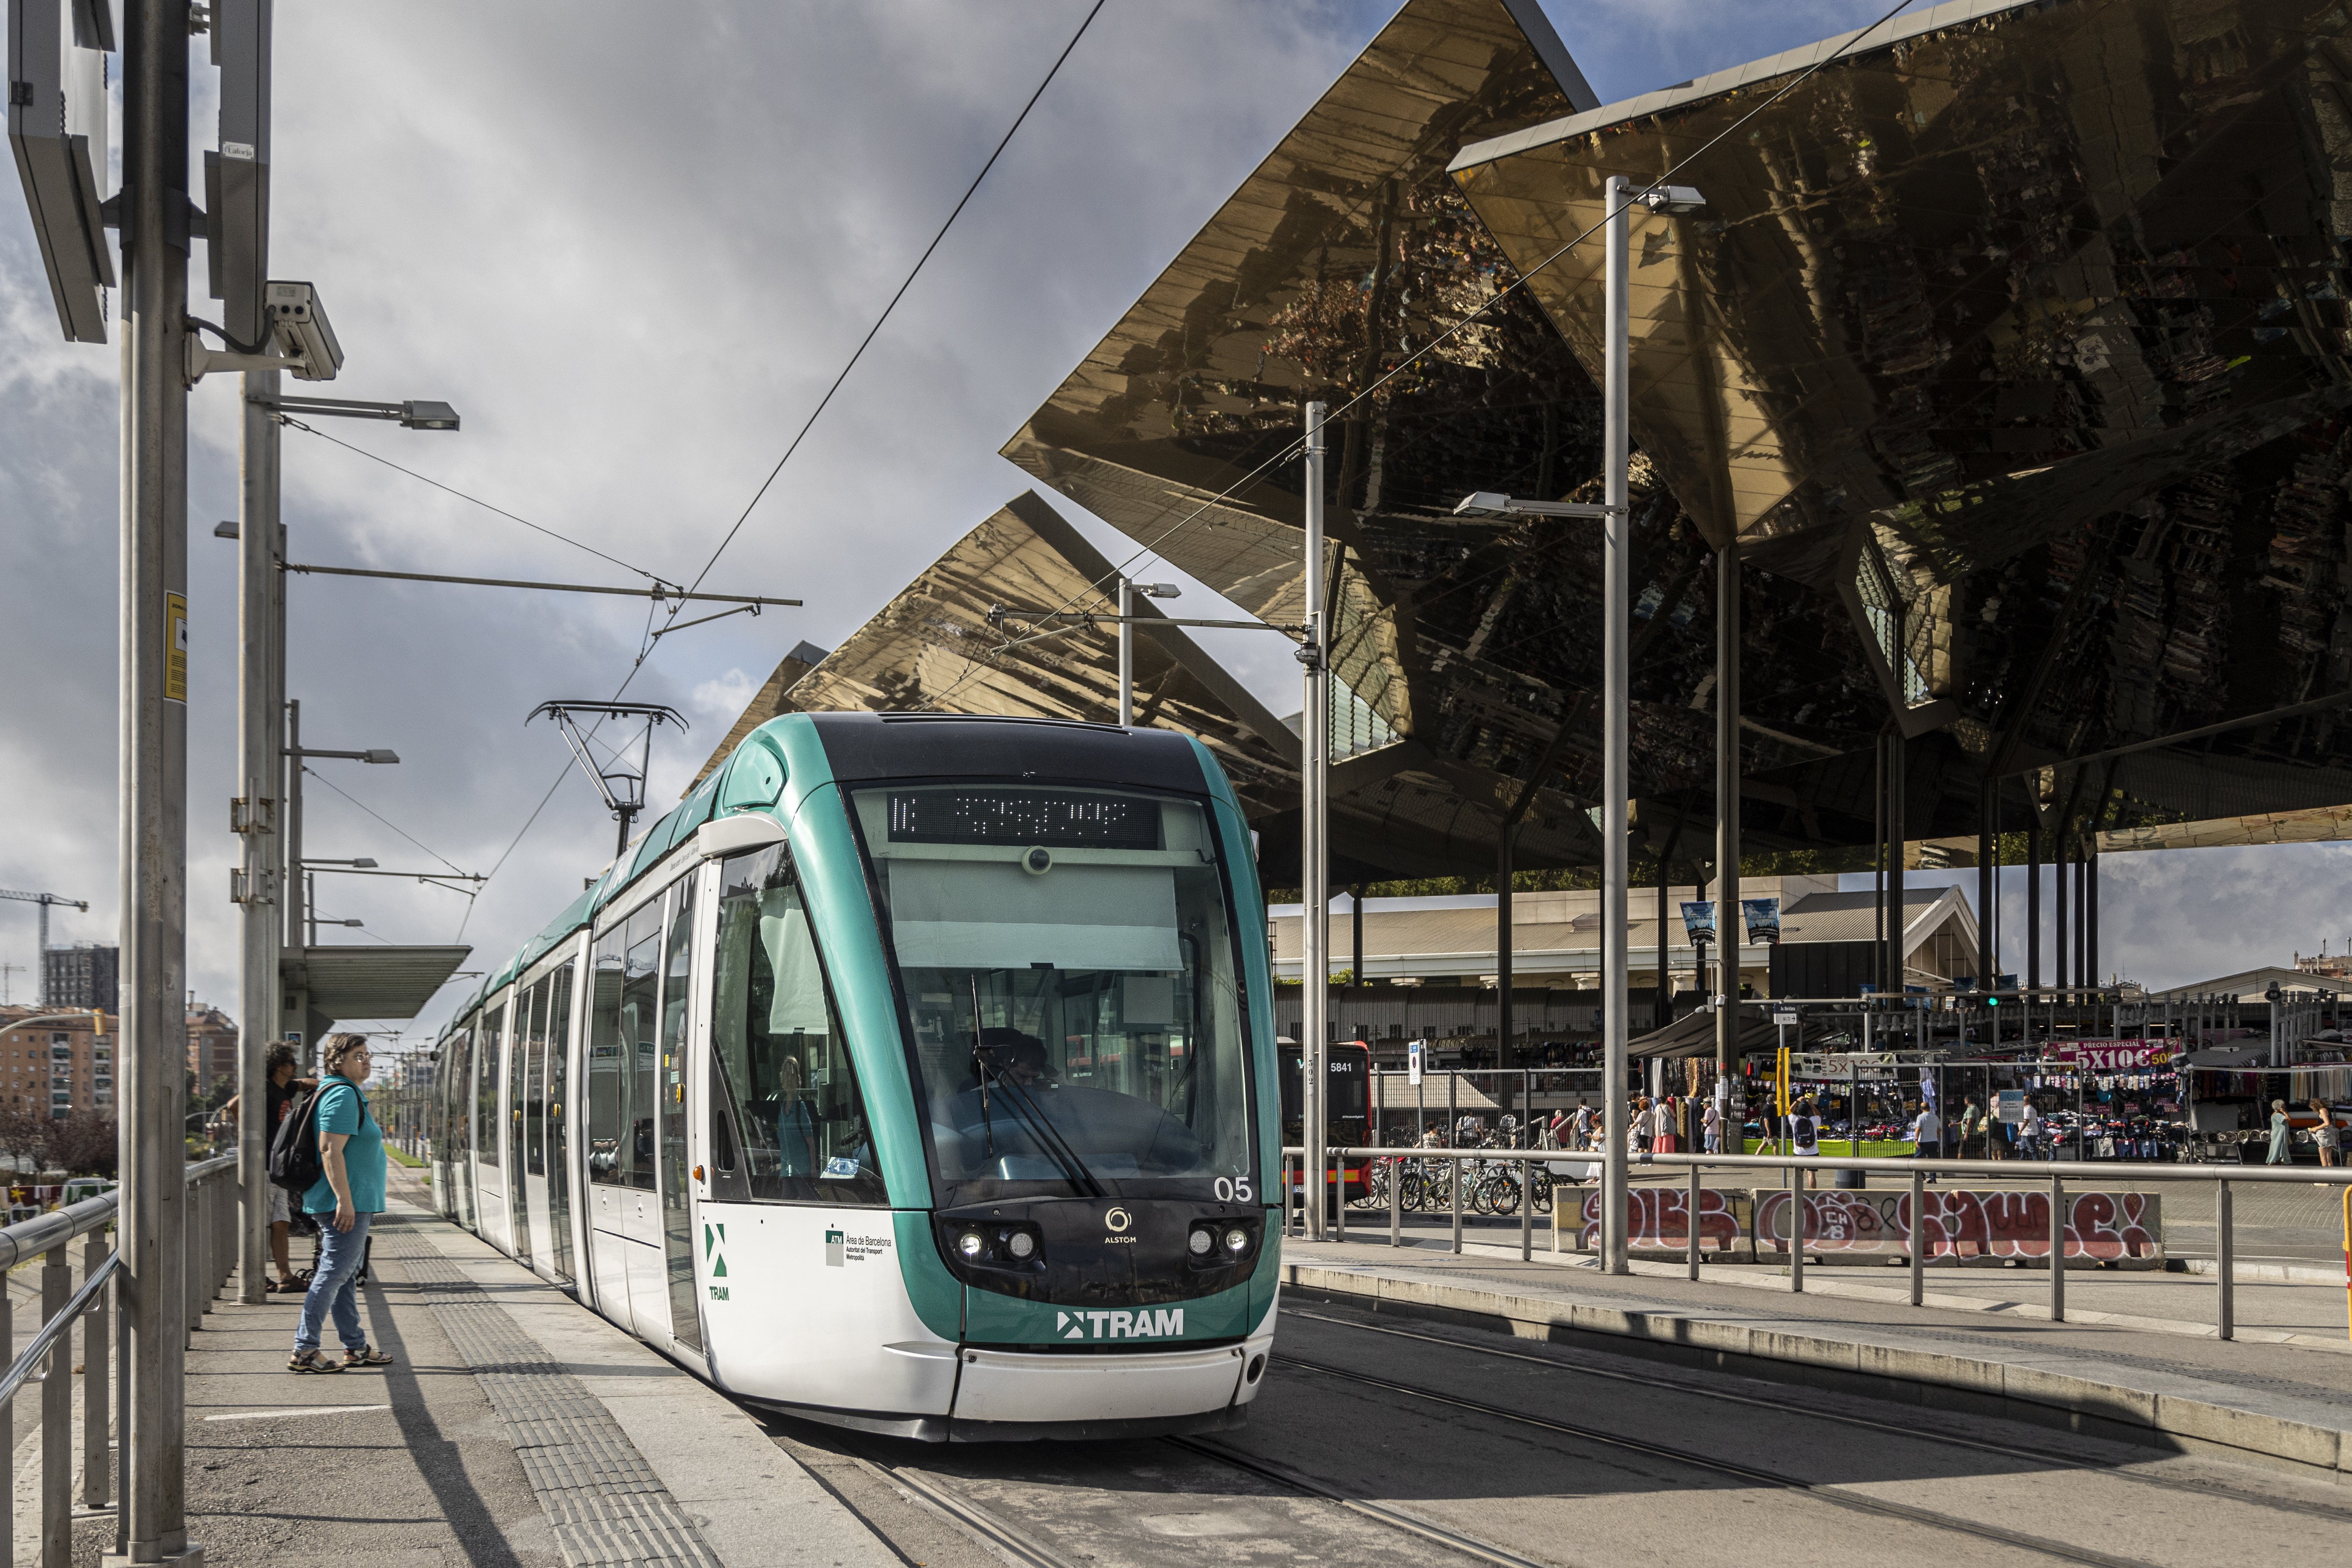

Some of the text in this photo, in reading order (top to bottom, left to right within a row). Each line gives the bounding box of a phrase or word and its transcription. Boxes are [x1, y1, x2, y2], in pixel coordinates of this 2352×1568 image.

[2075, 1049, 2150, 1069] 5X10€
[1331, 1063, 1351, 1072] 5841
[1214, 1176, 1252, 1202] 05
[831, 1235, 842, 1244] ATM
[846, 1233, 891, 1247] Àrea de Barcelona
[709, 1286, 729, 1301] TRAM
[1087, 1309, 1183, 1338] TRAM
